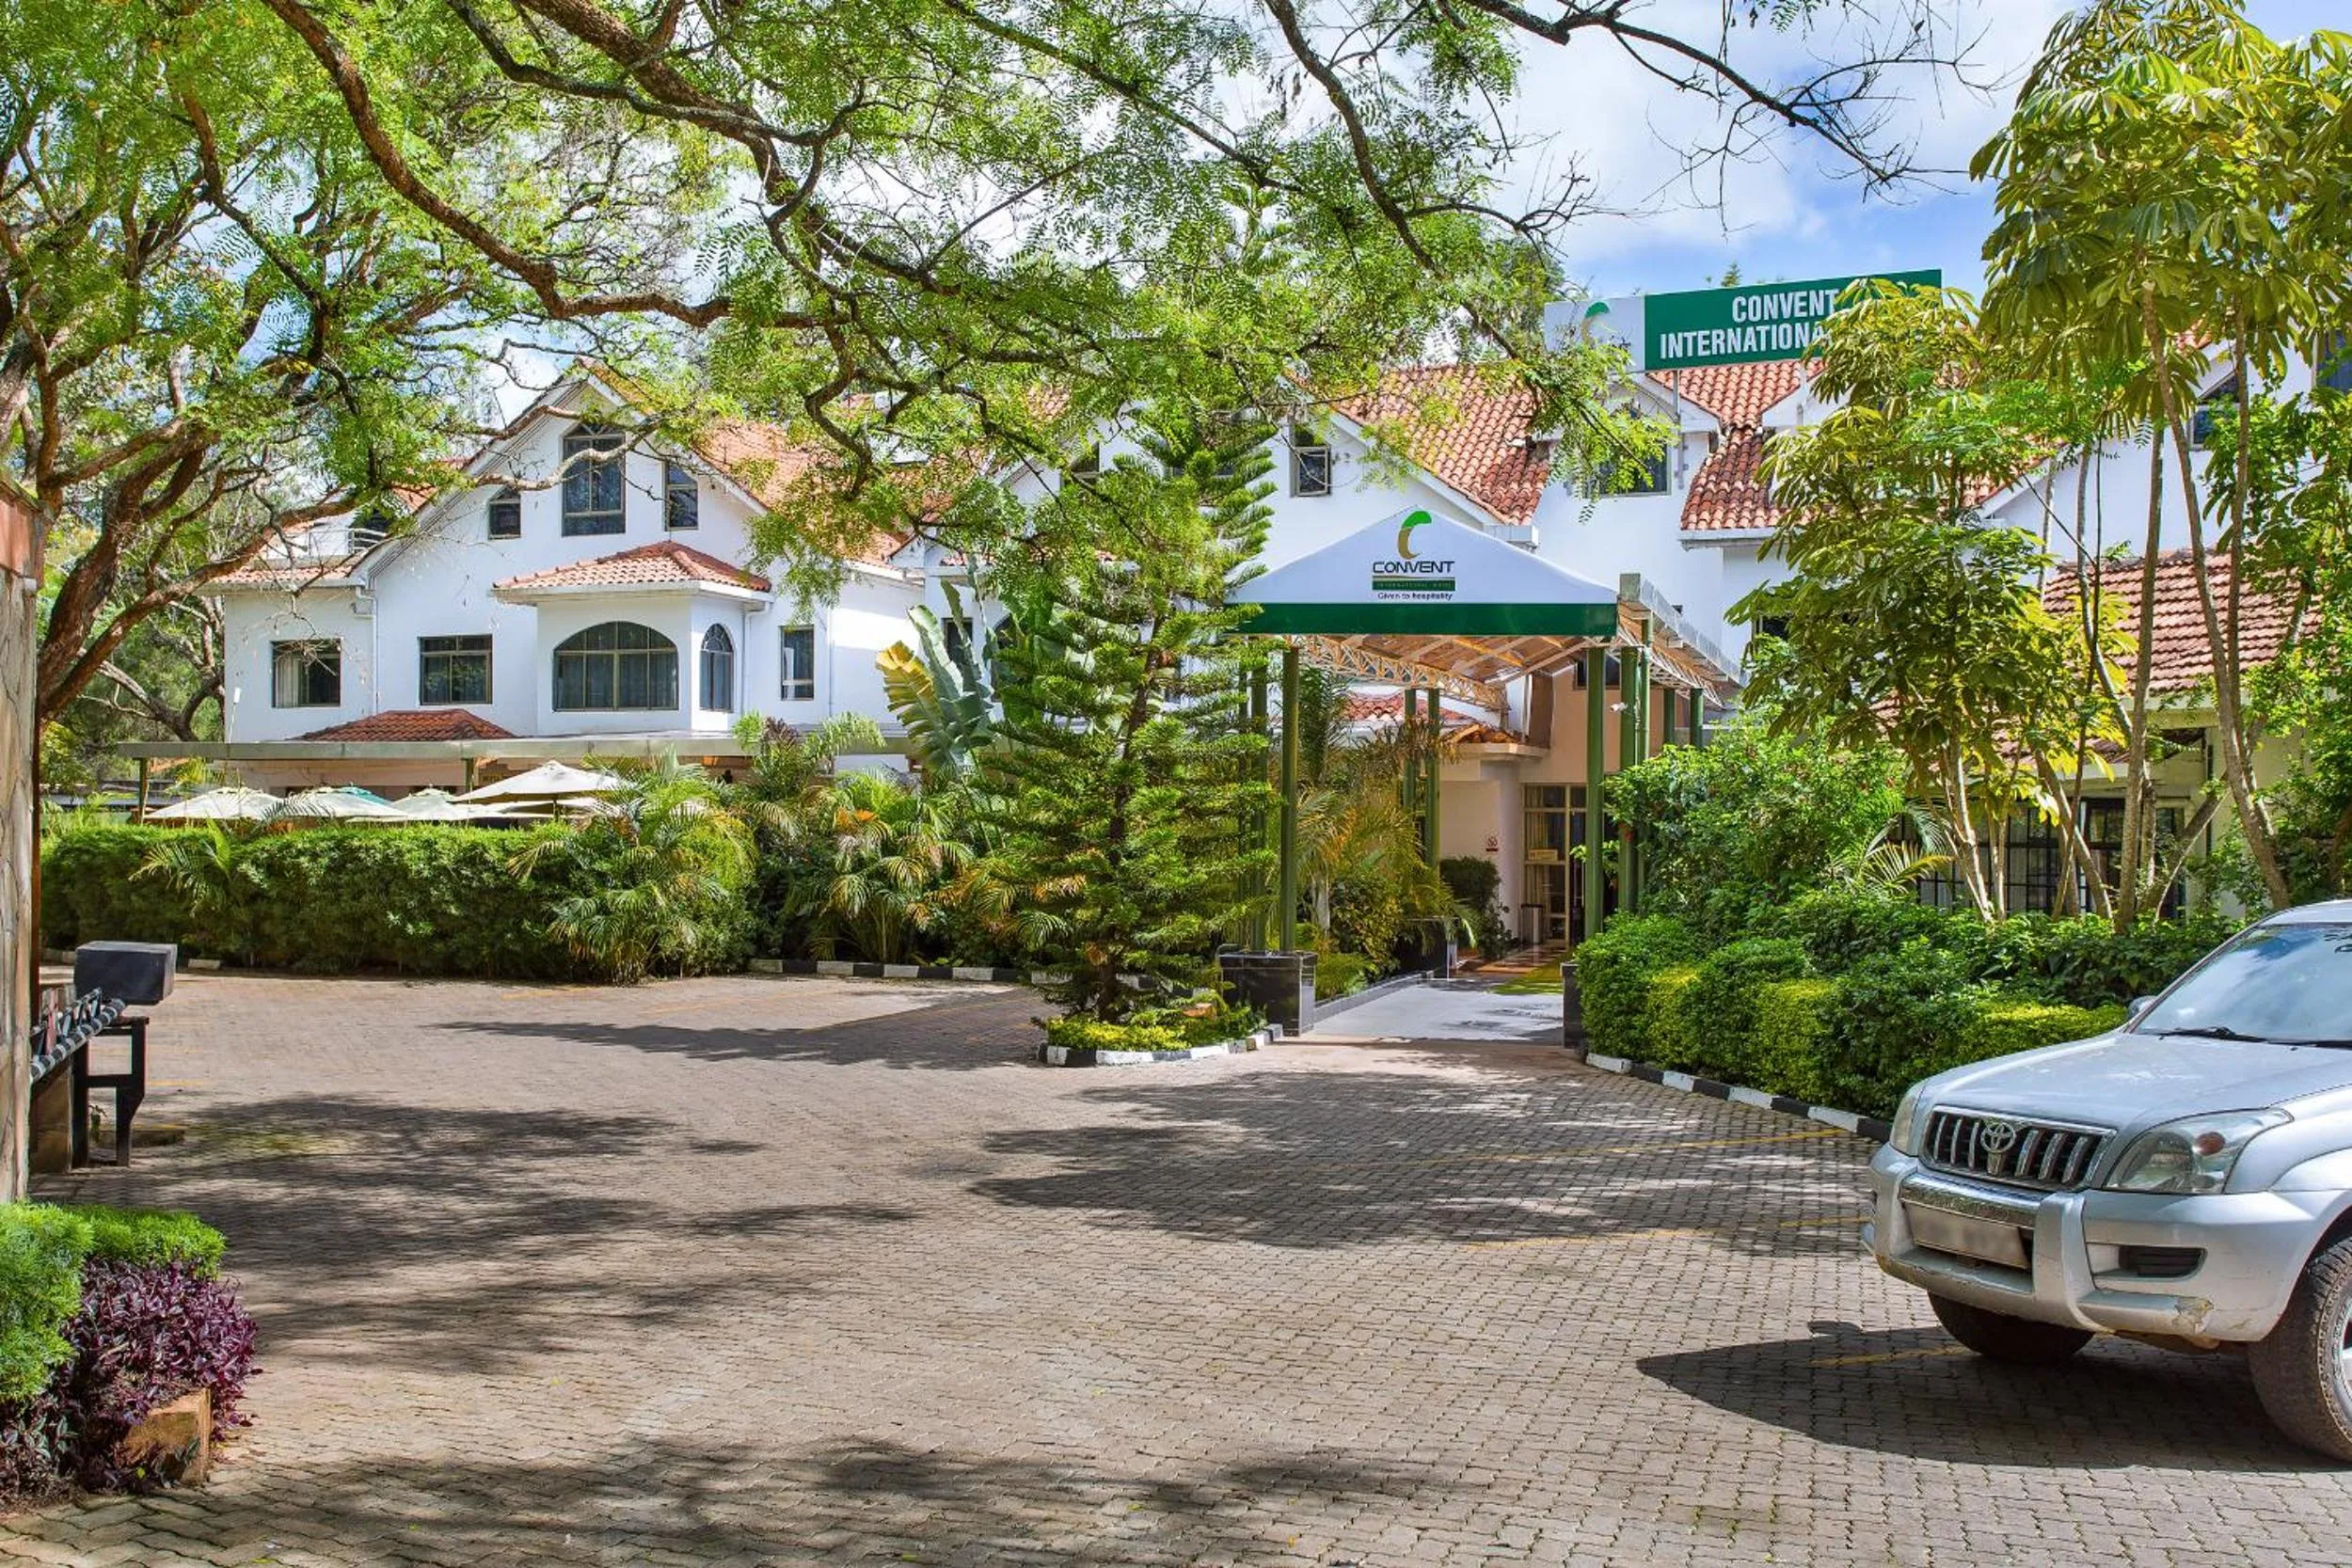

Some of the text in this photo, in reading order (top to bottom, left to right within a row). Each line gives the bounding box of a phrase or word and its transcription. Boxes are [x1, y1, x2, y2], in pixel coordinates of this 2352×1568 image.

[1732, 289, 1839, 323] CONVENT
[1660, 322, 1834, 360] INTERNATIONA
[1373, 561, 1455, 574] CONVENT
[1378, 592, 1401, 600] Given
[1412, 592, 1454, 602] hospitality
